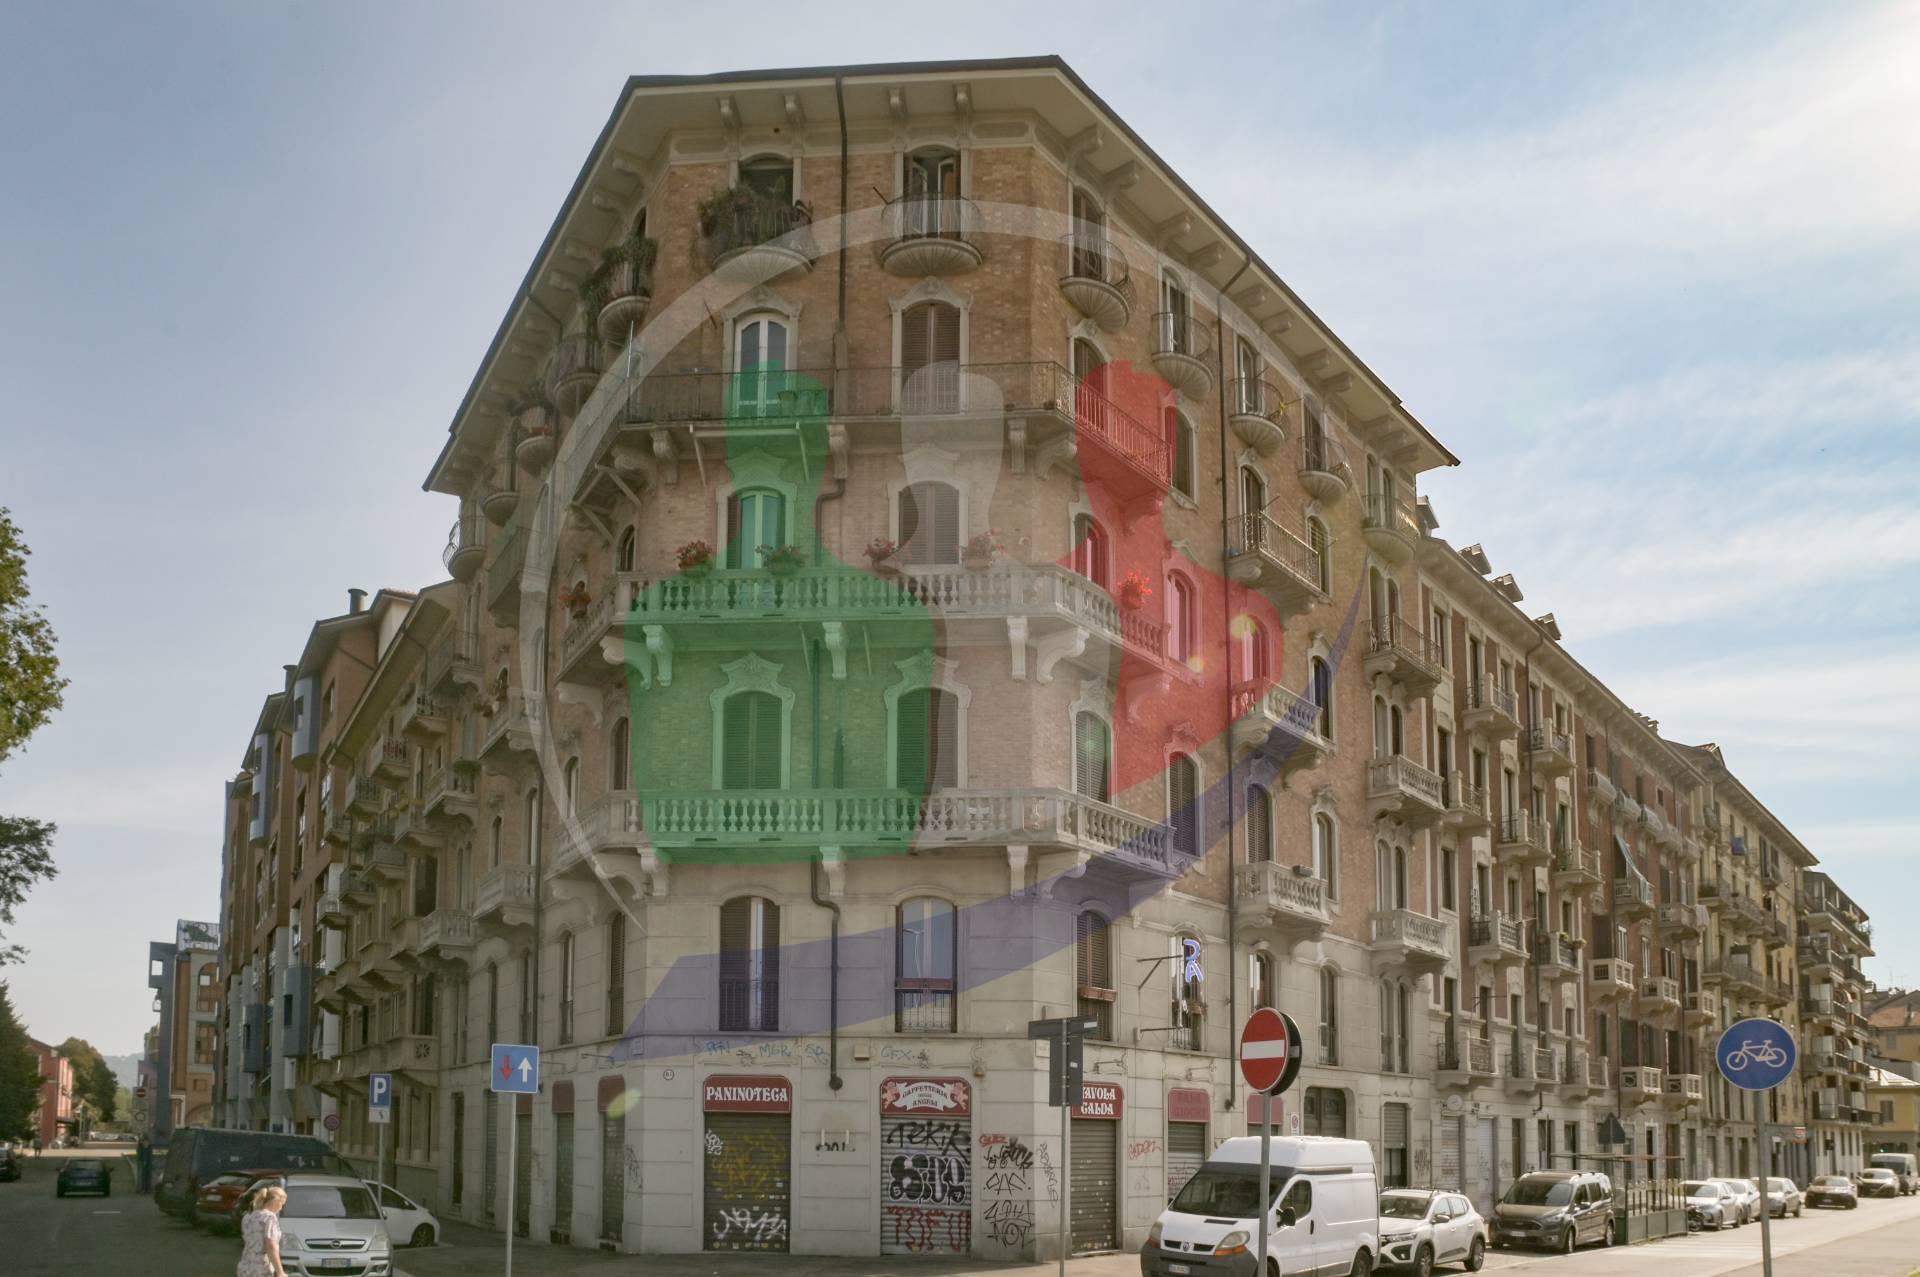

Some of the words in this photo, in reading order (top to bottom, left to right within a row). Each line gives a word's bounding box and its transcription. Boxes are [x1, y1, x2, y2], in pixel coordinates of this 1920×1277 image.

[373, 1077, 387, 1104] P
[705, 1086, 788, 1102] PANINOTECA
[1081, 1102, 1114, 1115] CALDA
